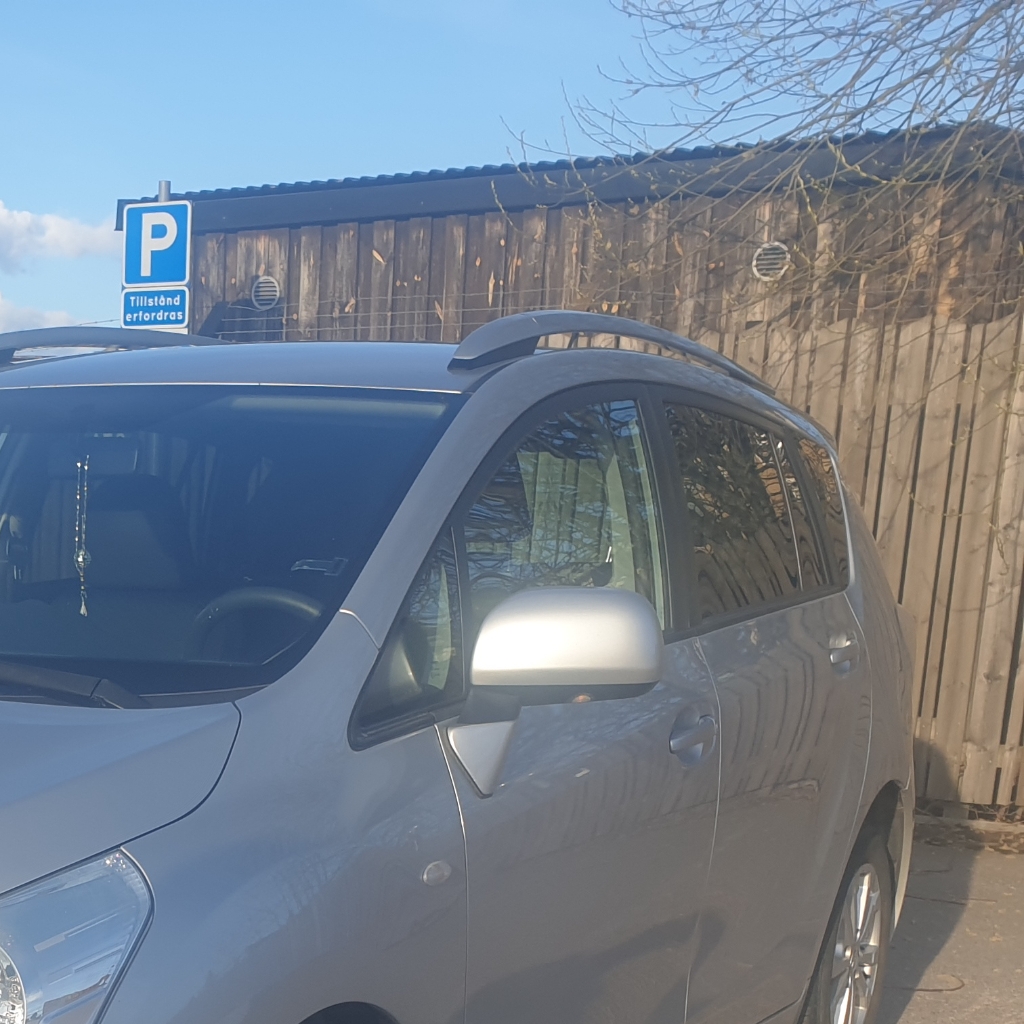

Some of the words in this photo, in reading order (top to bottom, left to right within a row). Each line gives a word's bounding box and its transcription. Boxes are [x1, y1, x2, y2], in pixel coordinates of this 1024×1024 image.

[140, 211, 178, 277] P
[129, 294, 181, 307] Tillstånd
[125, 310, 183, 322] erfordras
